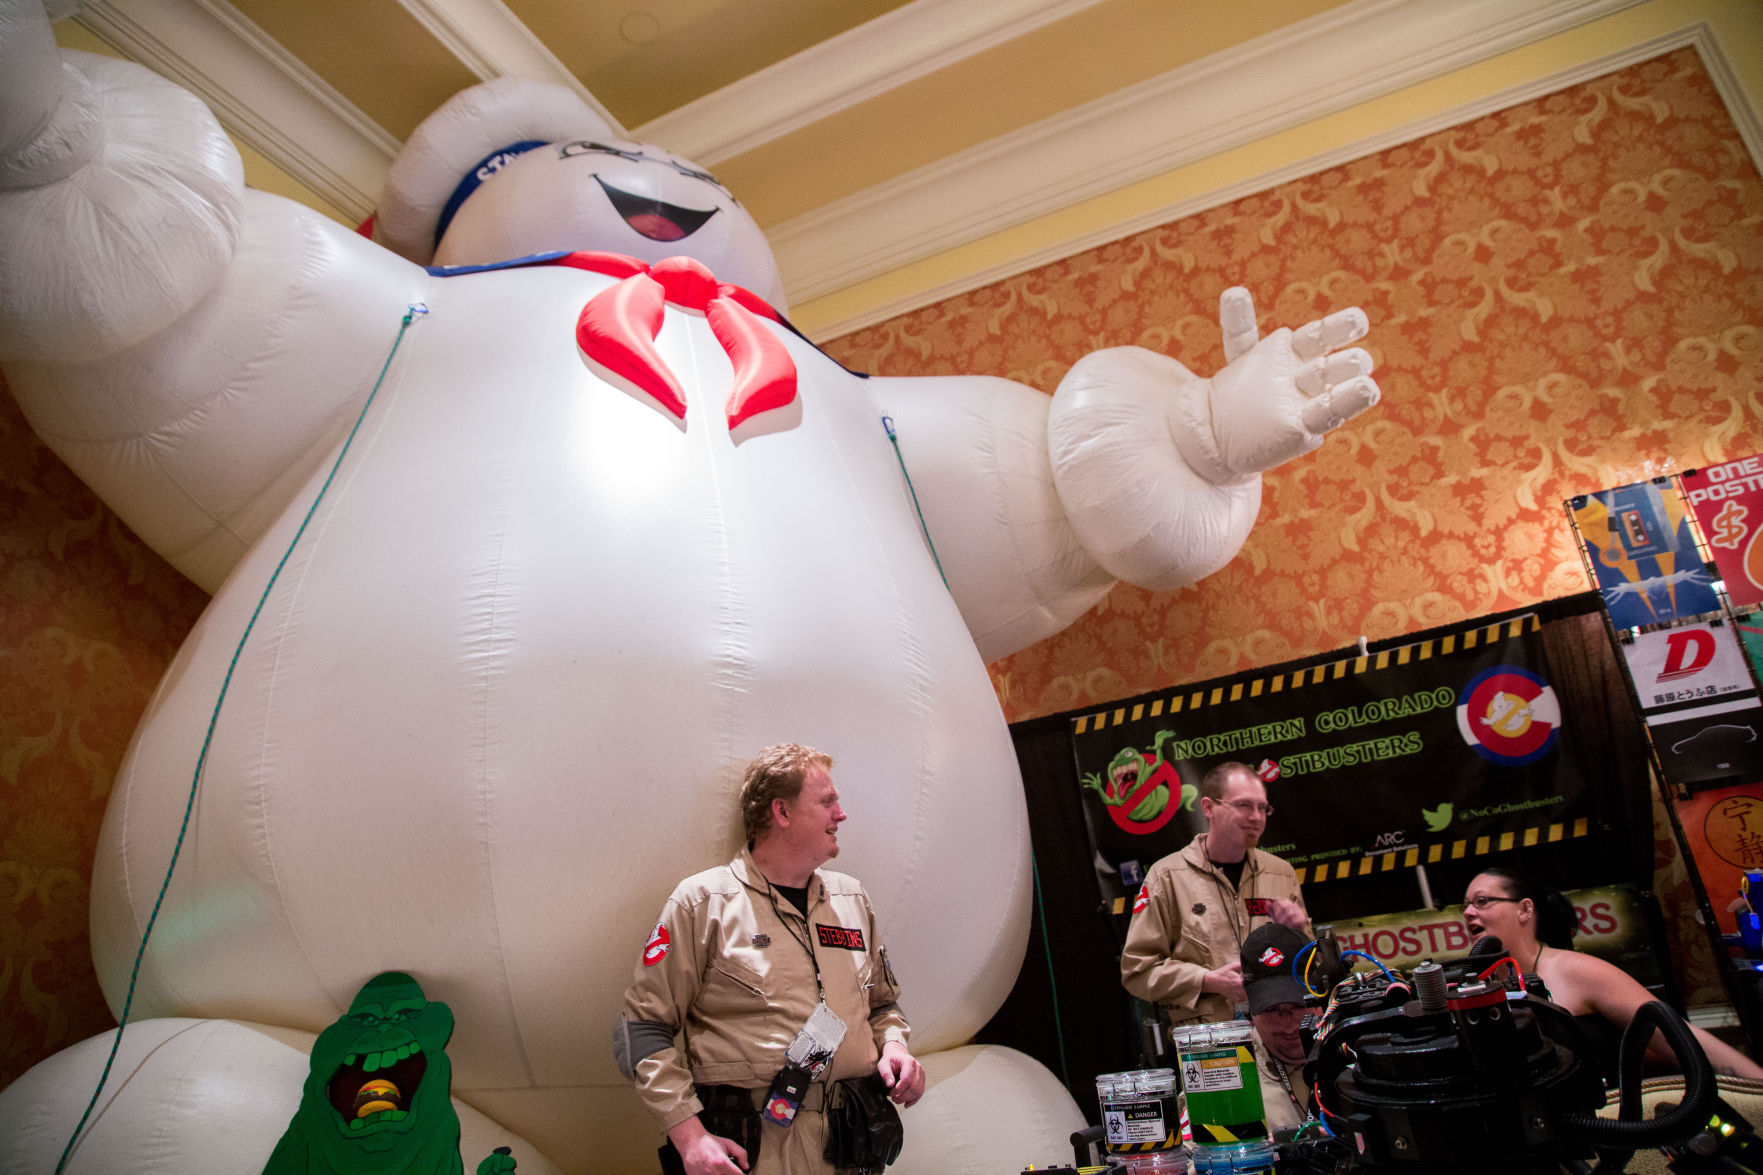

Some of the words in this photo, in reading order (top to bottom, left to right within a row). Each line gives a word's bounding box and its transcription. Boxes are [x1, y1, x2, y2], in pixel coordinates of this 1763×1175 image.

[476, 152, 521, 181] STA
[1707, 457, 1763, 483] ONE
[1689, 474, 1763, 506] POST
[1173, 717, 1306, 760] NORTHERN
[1315, 686, 1455, 732] COLORADO
[1258, 731, 1423, 780] STBUSTERS
[1258, 843, 1296, 854] busters
[818, 926, 863, 948] STEBBINS
